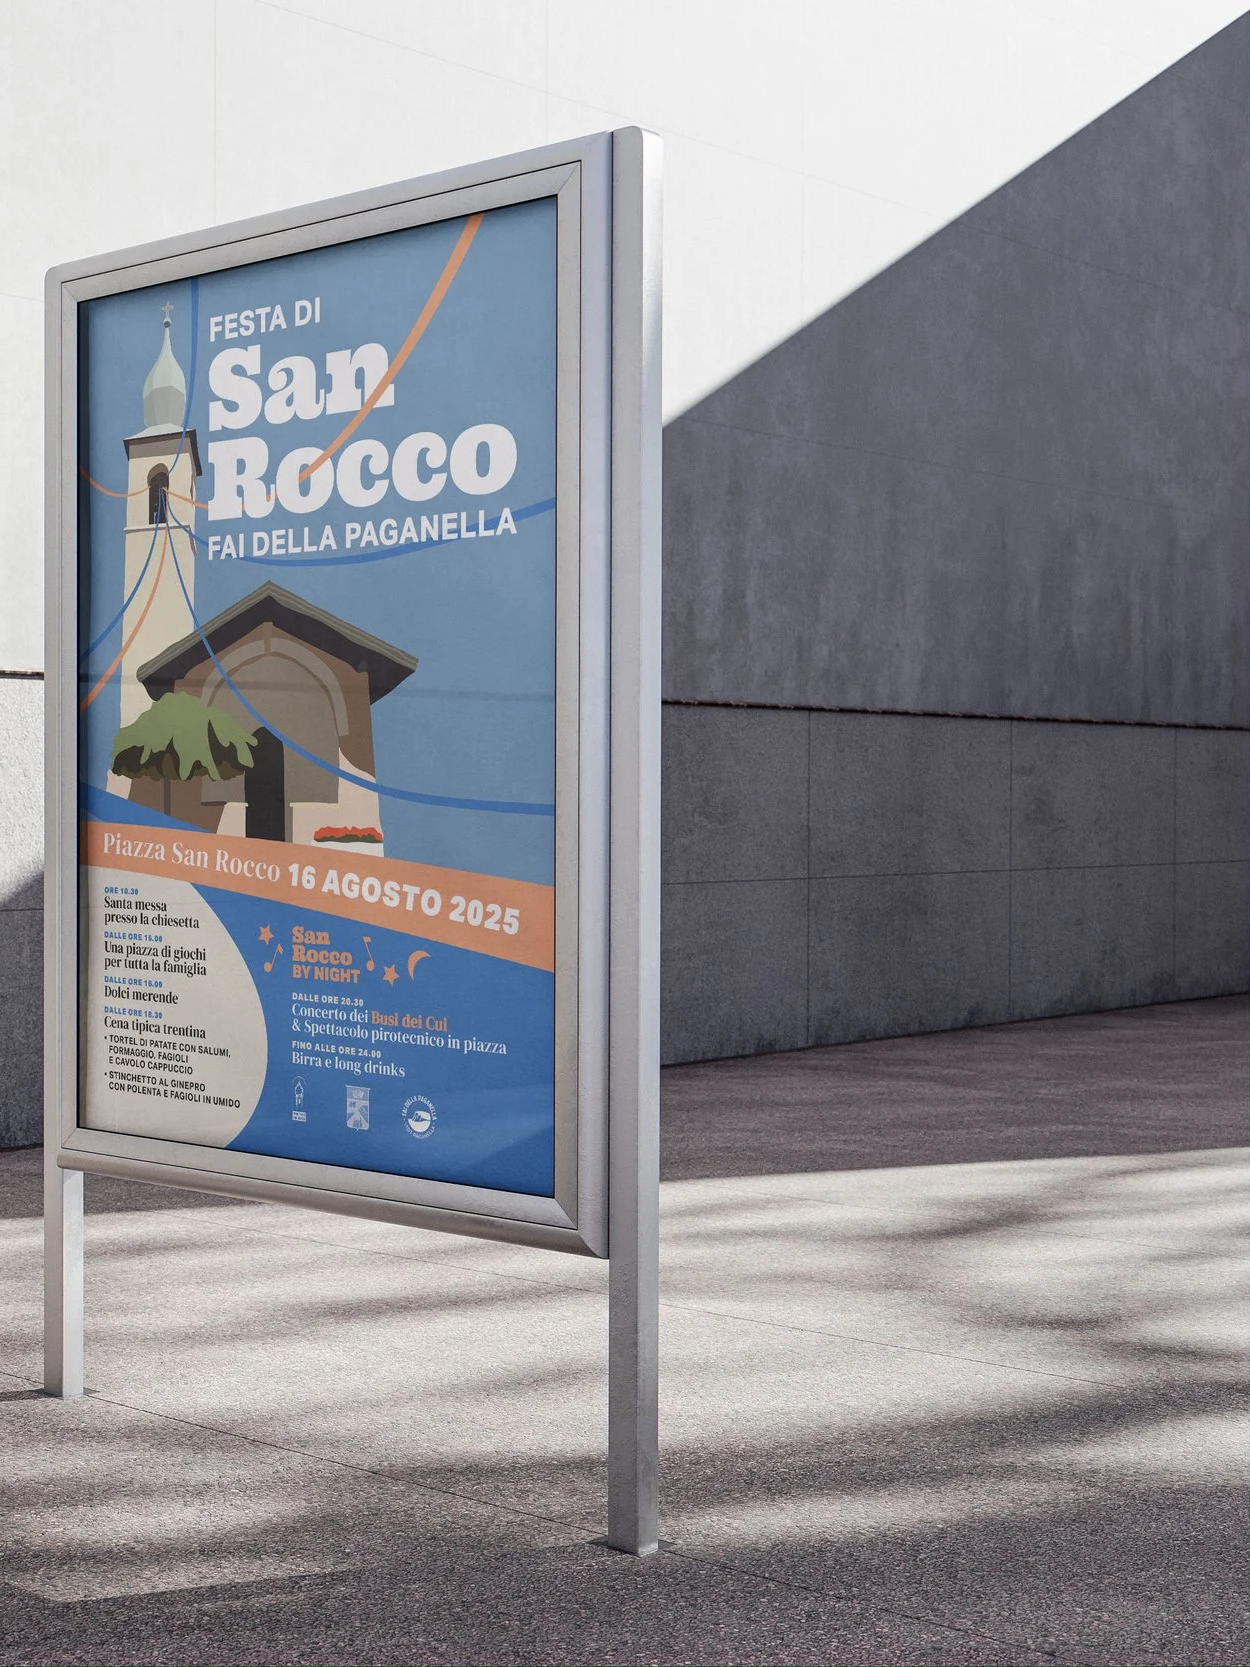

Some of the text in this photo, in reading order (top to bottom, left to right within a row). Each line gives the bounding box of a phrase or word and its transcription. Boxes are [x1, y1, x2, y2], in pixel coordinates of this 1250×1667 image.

[210, 298, 320, 341] FESTA DI
[209, 342, 395, 431] San
[208, 423, 517, 521] Rocco
[209, 507, 516, 560] FAI DELLA PAGANELLA
[103, 832, 520, 935] Piazza San Rocco 16 AGOSTO 2025
[105, 896, 166, 912] Santa messa
[105, 913, 199, 928] presso la chiesetta
[105, 931, 126, 939] DALLE
[292, 926, 331, 945] San
[105, 941, 206, 962] Una piazza di giochi
[292, 944, 352, 965] Rocco
[105, 958, 206, 977] per tutta la famiglia
[292, 965, 360, 983] BY NIGHT
[105, 976, 126, 984] DALLE
[145, 979, 162, 987] 16.00
[105, 986, 178, 1004] Dolci merende
[292, 993, 364, 1006] DALLE ORE 20.30
[105, 1006, 162, 1019] DALLE ORE 18.30
[292, 1004, 346, 1020] Concerto
[350, 1007, 368, 1023] dei
[372, 1011, 398, 1027] Busi
[402, 1014, 422, 1029] dei
[105, 1016, 206, 1039] Cena tipica trentina
[292, 1020, 506, 1055] & Spettacolo pirotecnico in piazza
[109, 1046, 188, 1063] FORMAGGIO, FAGIOLI
[110, 1035, 230, 1058] TORTEL DI PATATE CON SALUMI,
[292, 1041, 381, 1058] FINO ALLE ORE 24.00
[109, 1056, 193, 1075] E CAVOLO CAPPUCCIO
[292, 1052, 405, 1078] Birra e long drinks
[109, 1071, 205, 1092] STINCHETTO AL GINEPRO
[109, 1082, 125, 1091] CON
[127, 1085, 161, 1097] POLENTA
[171, 1091, 200, 1102] FAGIOLI
[203, 1095, 211, 1104] IN
[213, 1097, 240, 1108] UMIDO
